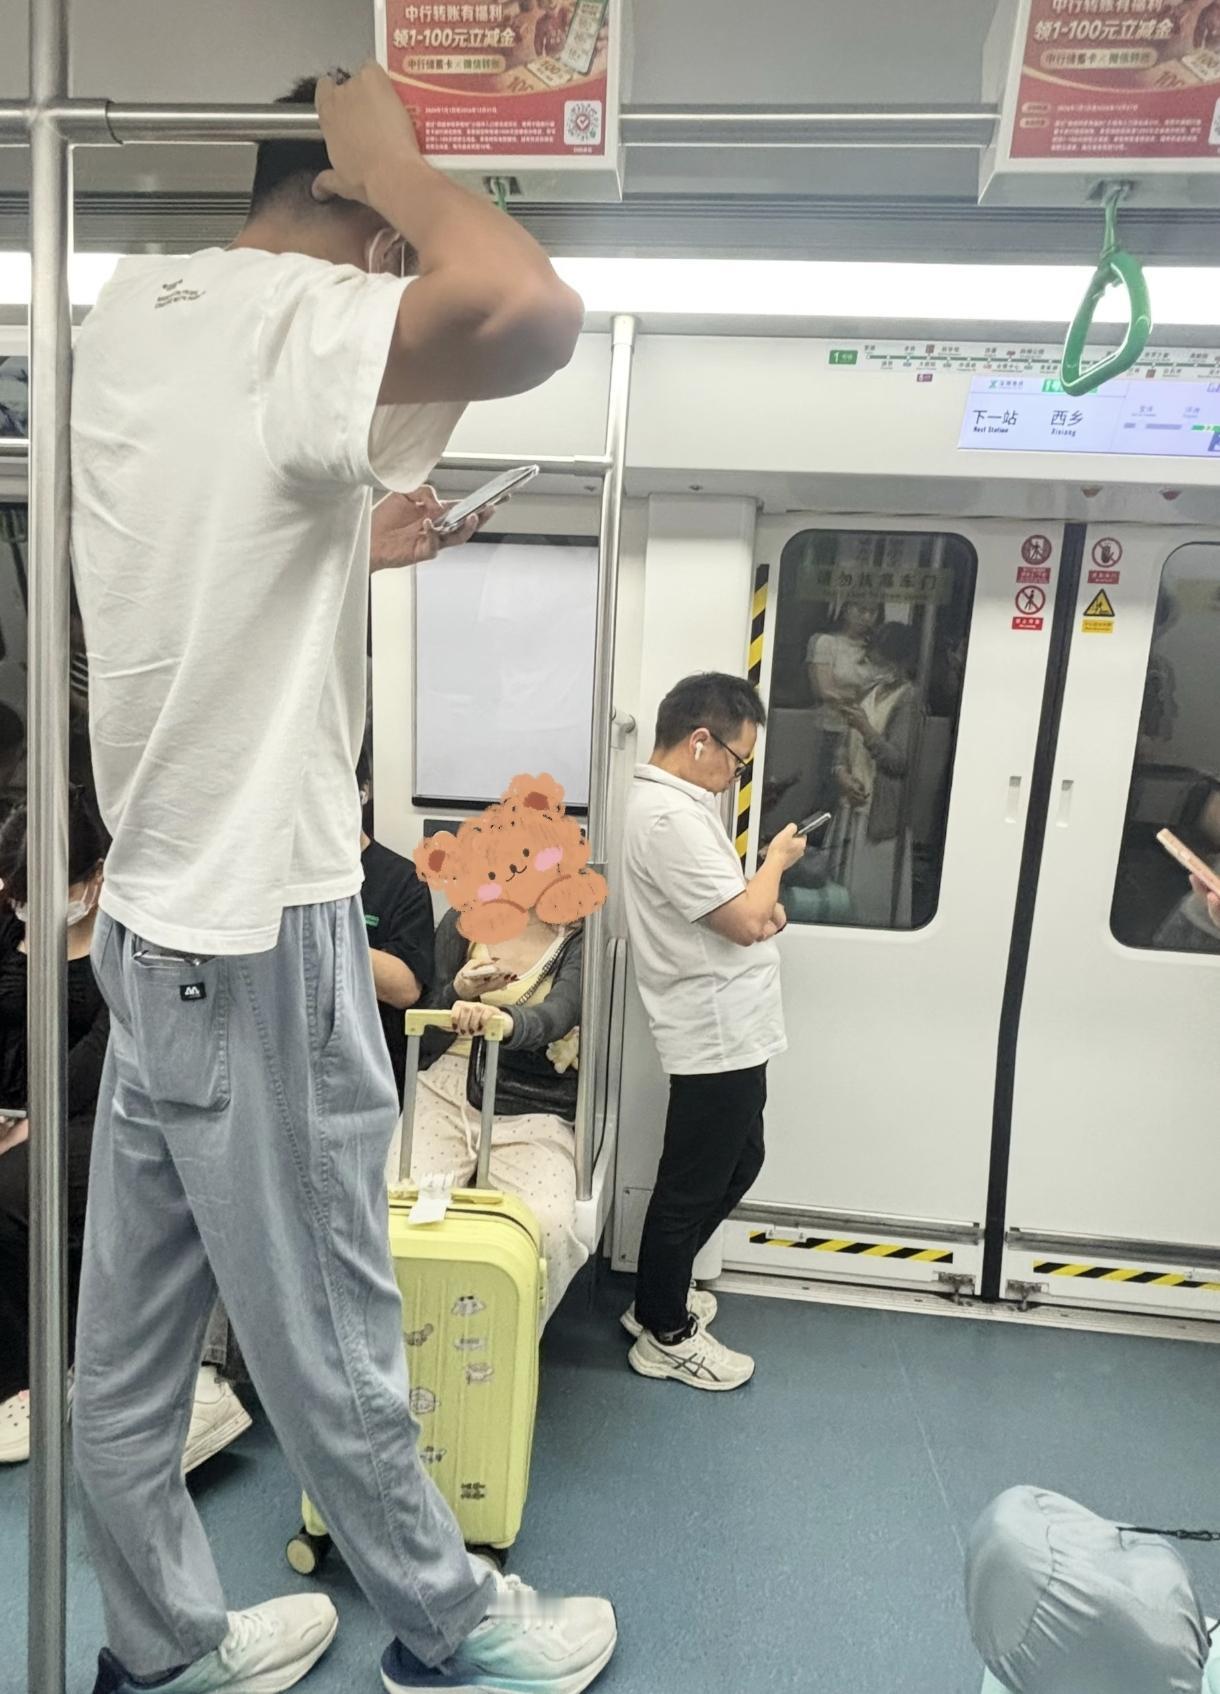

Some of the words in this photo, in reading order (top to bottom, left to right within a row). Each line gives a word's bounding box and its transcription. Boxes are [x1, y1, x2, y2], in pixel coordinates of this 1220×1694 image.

[405, 4, 502, 23] 中行转账有福利
[392, 28, 516, 48] 领1-100元立减金
[1034, 18, 1174, 41] 领1-100元立减金
[972, 409, 1018, 426] 下一站
[1050, 409, 1083, 427] 西乡
